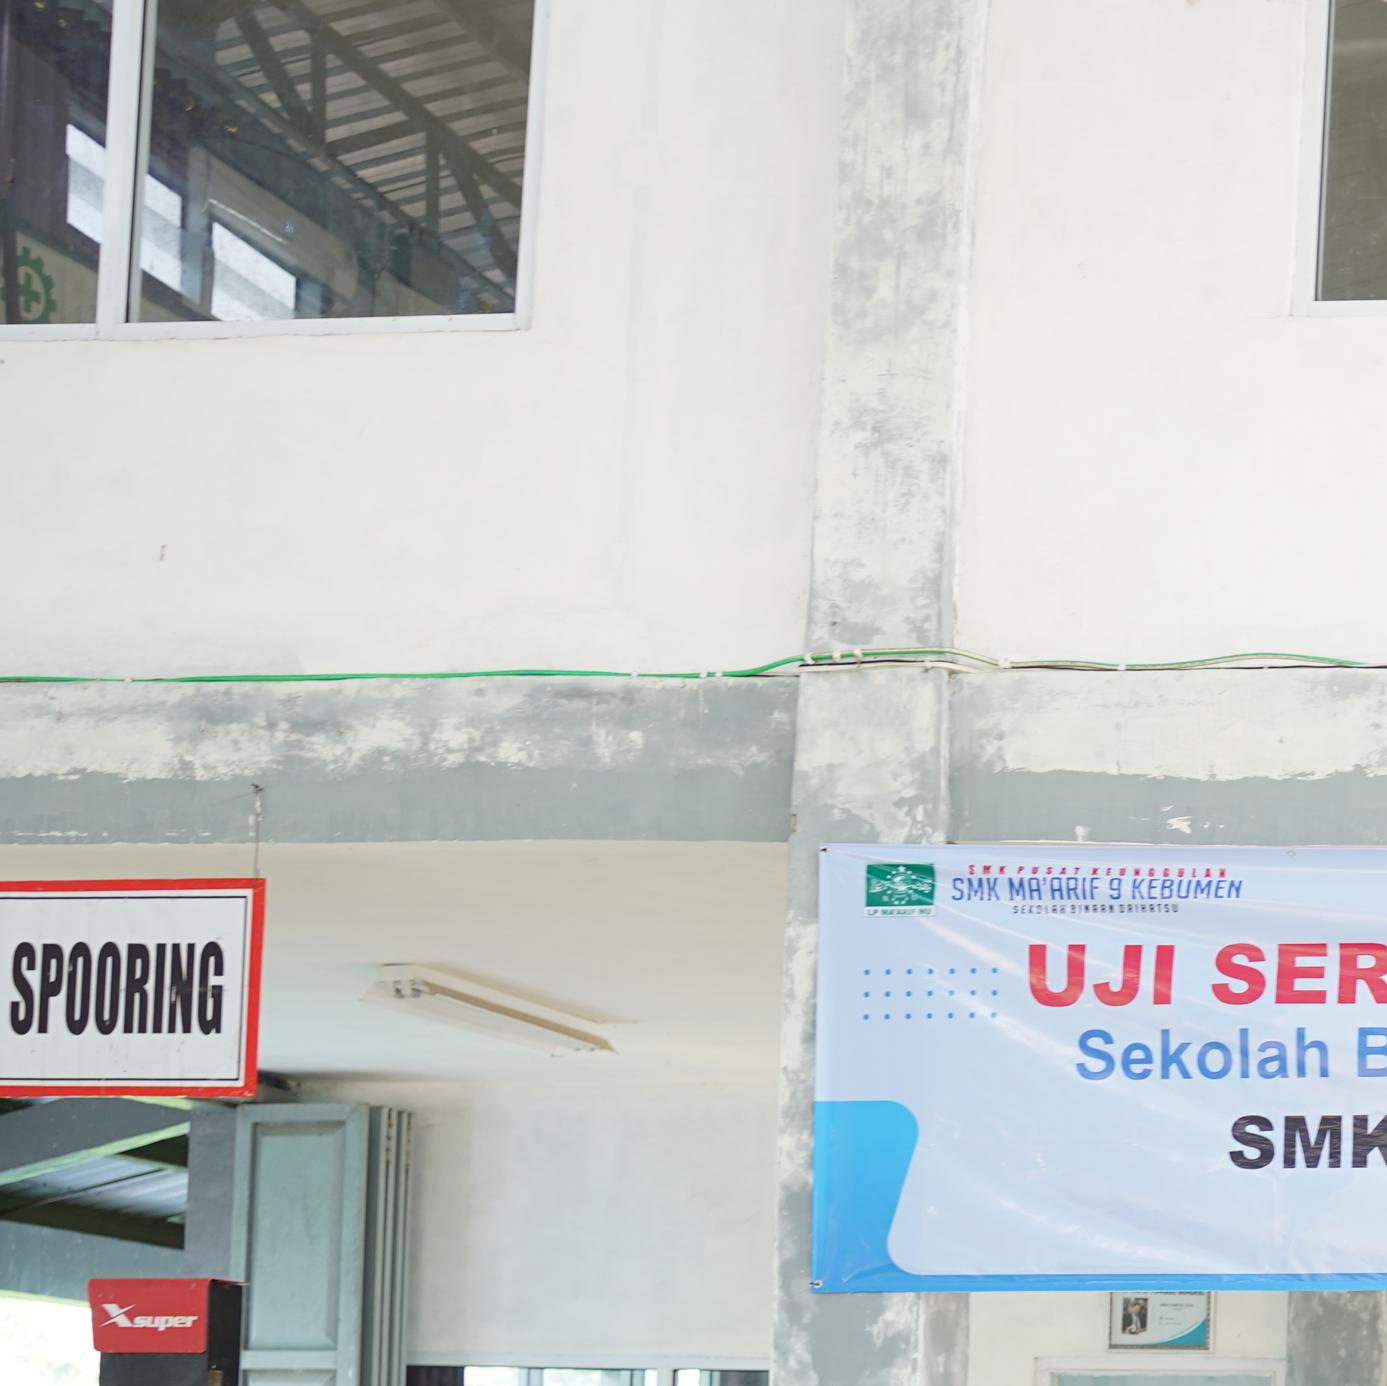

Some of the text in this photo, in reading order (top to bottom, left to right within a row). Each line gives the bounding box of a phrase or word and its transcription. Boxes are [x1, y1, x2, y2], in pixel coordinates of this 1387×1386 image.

[952, 877, 1001, 901] SMK
[1008, 877, 1100, 901] MA'ARIF
[1109, 878, 1123, 900] 9
[1131, 878, 1244, 900] KEBUMEN
[968, 864, 1006, 875] SMK
[1016, 866, 1081, 875] PUSAT
[9, 940, 225, 1036] SPOORING
[1027, 943, 1176, 1008] UJI
[1074, 1026, 1330, 1082] Sekolah
[99, 1303, 199, 1331] Xsuper
